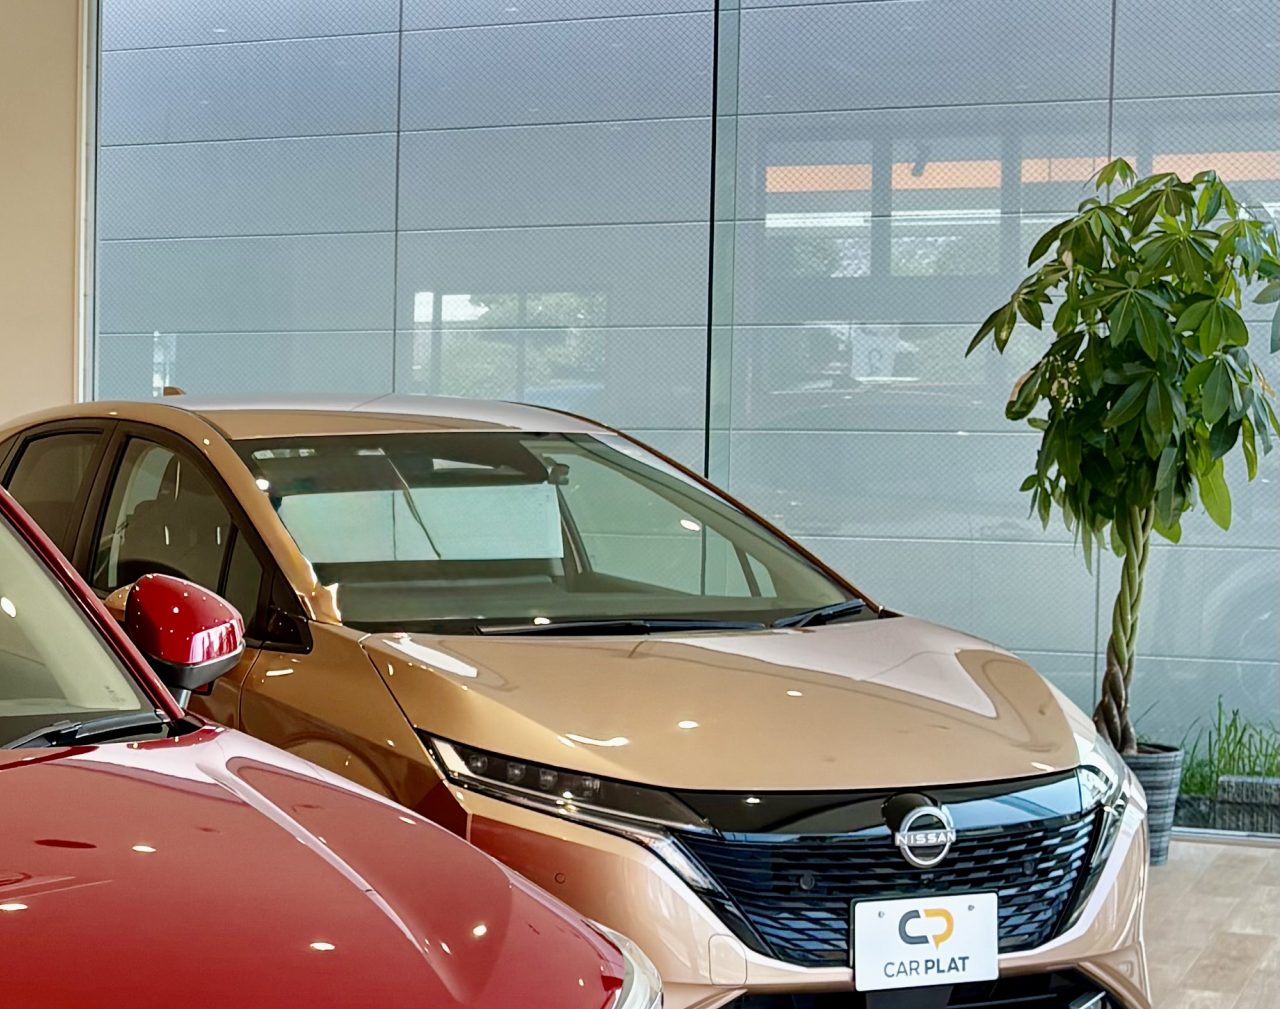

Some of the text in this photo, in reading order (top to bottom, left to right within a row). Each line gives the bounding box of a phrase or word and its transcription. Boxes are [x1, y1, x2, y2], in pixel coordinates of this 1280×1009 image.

[895, 828, 957, 846] NISSAN
[883, 956, 970, 978] CAR PLAT
